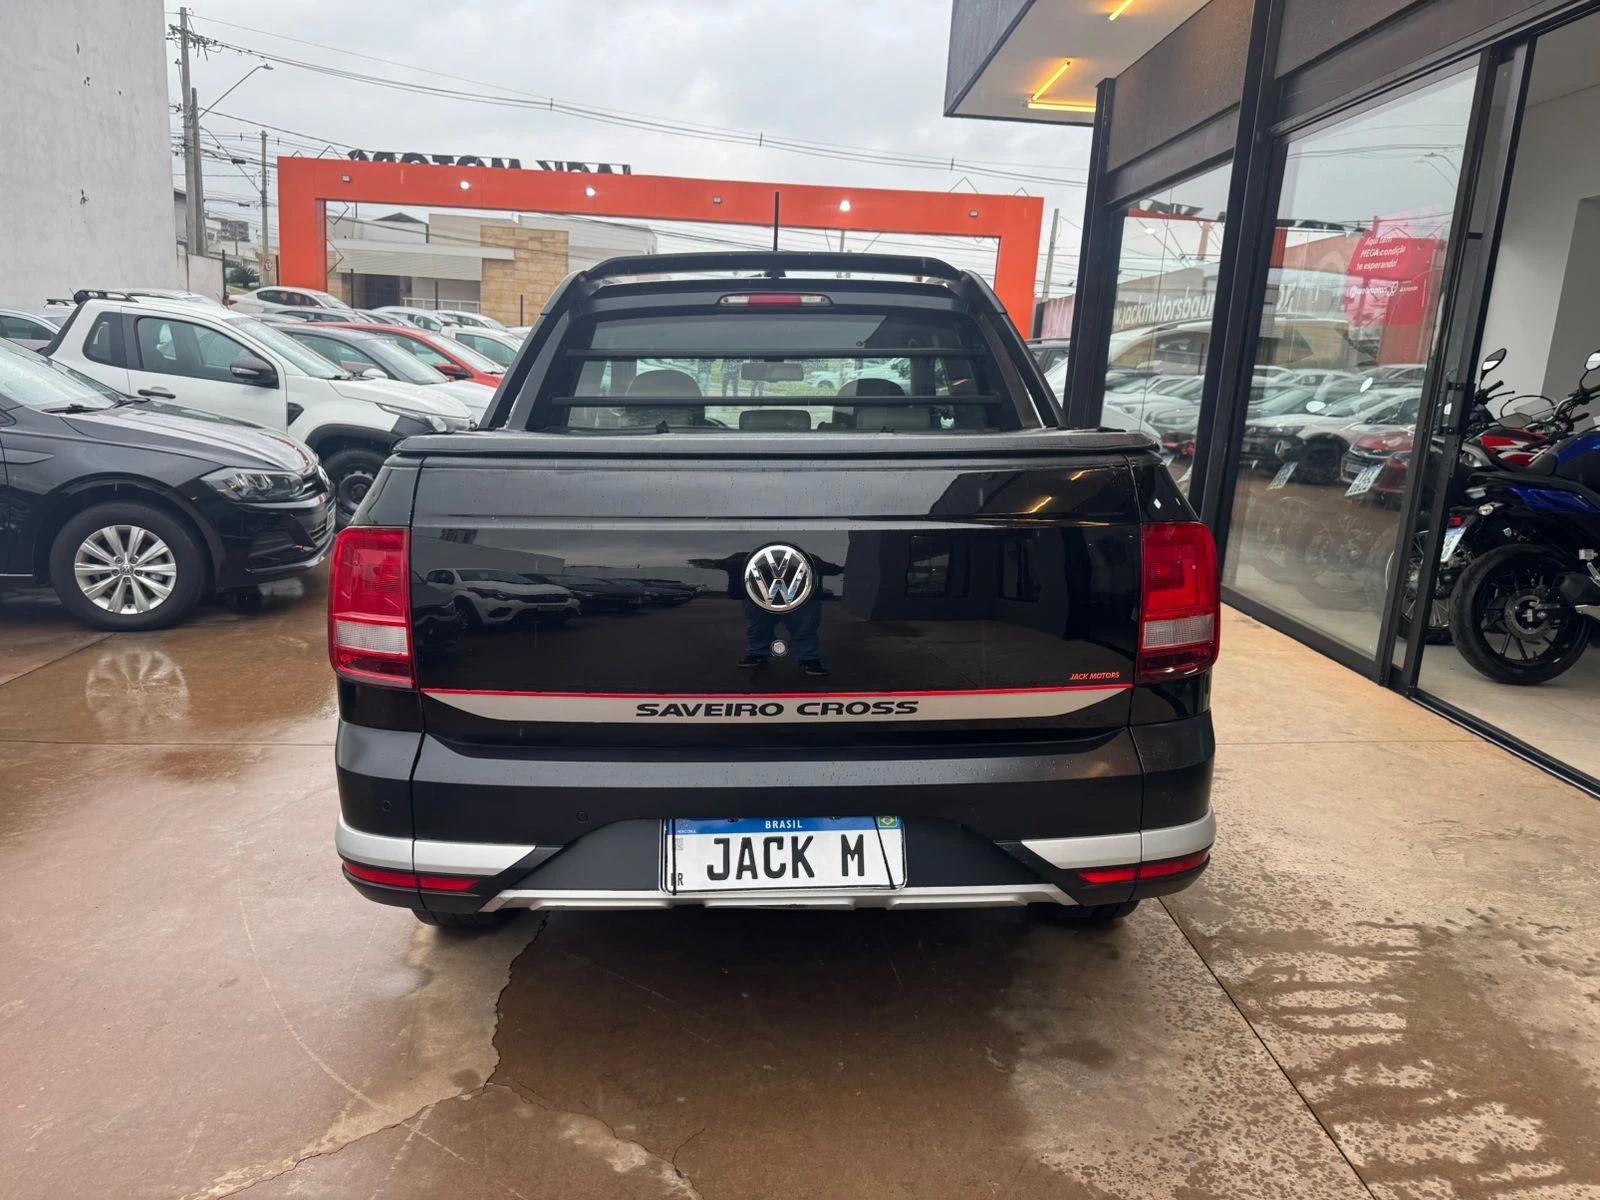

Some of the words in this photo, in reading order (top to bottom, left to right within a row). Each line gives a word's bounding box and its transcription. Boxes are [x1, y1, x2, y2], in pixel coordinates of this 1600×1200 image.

[1360, 247, 1379, 258] MEGA
[1356, 262, 1364, 270] te
[1070, 672, 1089, 681] JACK
[1089, 671, 1120, 680] MOTORS
[635, 702, 784, 718] SAVEIRO
[796, 700, 919, 716] CROSS
[765, 819, 803, 829] BRASIL
[706, 835, 815, 881] JACK
[840, 833, 865, 877] M
